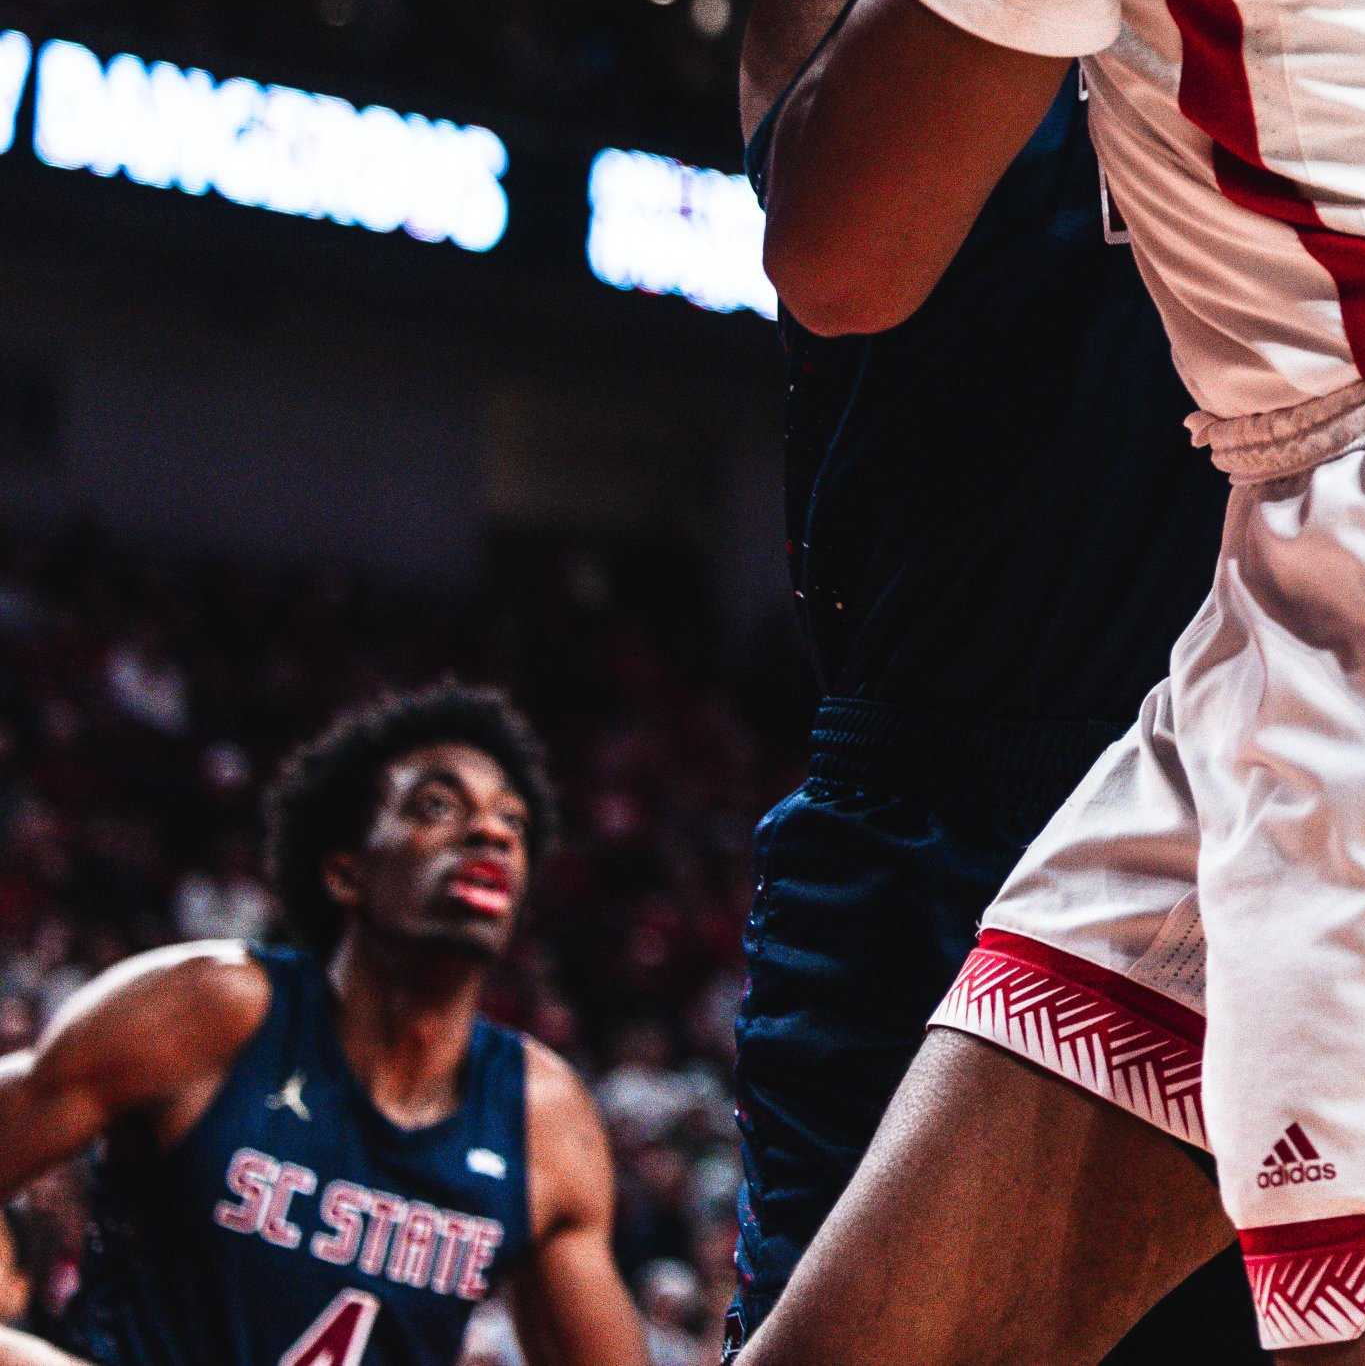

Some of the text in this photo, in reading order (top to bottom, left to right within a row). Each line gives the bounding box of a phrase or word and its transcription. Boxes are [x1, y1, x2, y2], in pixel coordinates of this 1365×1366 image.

[1257, 1161, 1337, 1189] adidas
[213, 1146, 504, 1302] SC STATE
